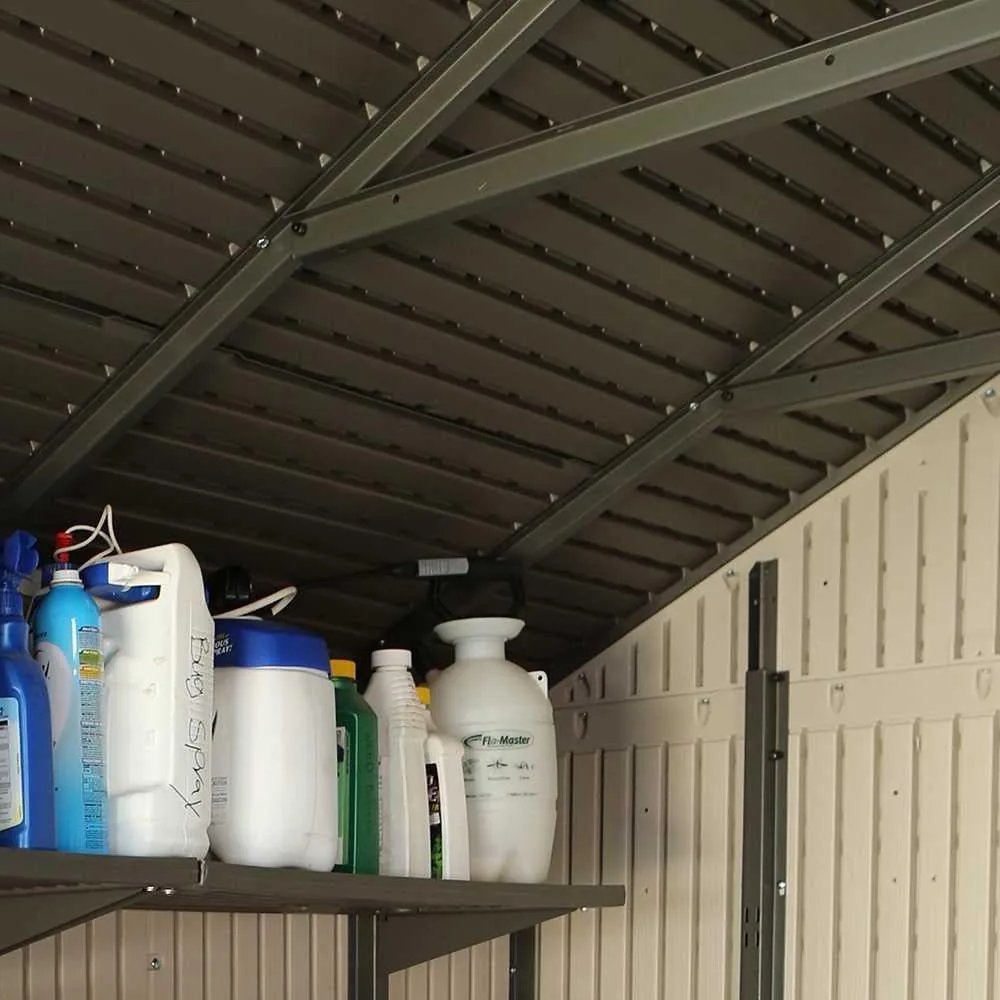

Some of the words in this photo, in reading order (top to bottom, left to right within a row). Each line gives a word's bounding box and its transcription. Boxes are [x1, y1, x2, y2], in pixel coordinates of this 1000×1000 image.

[184, 634, 210, 698] Bug
[169, 717, 207, 818] Spray
[482, 735, 531, 746] Flo-Master
